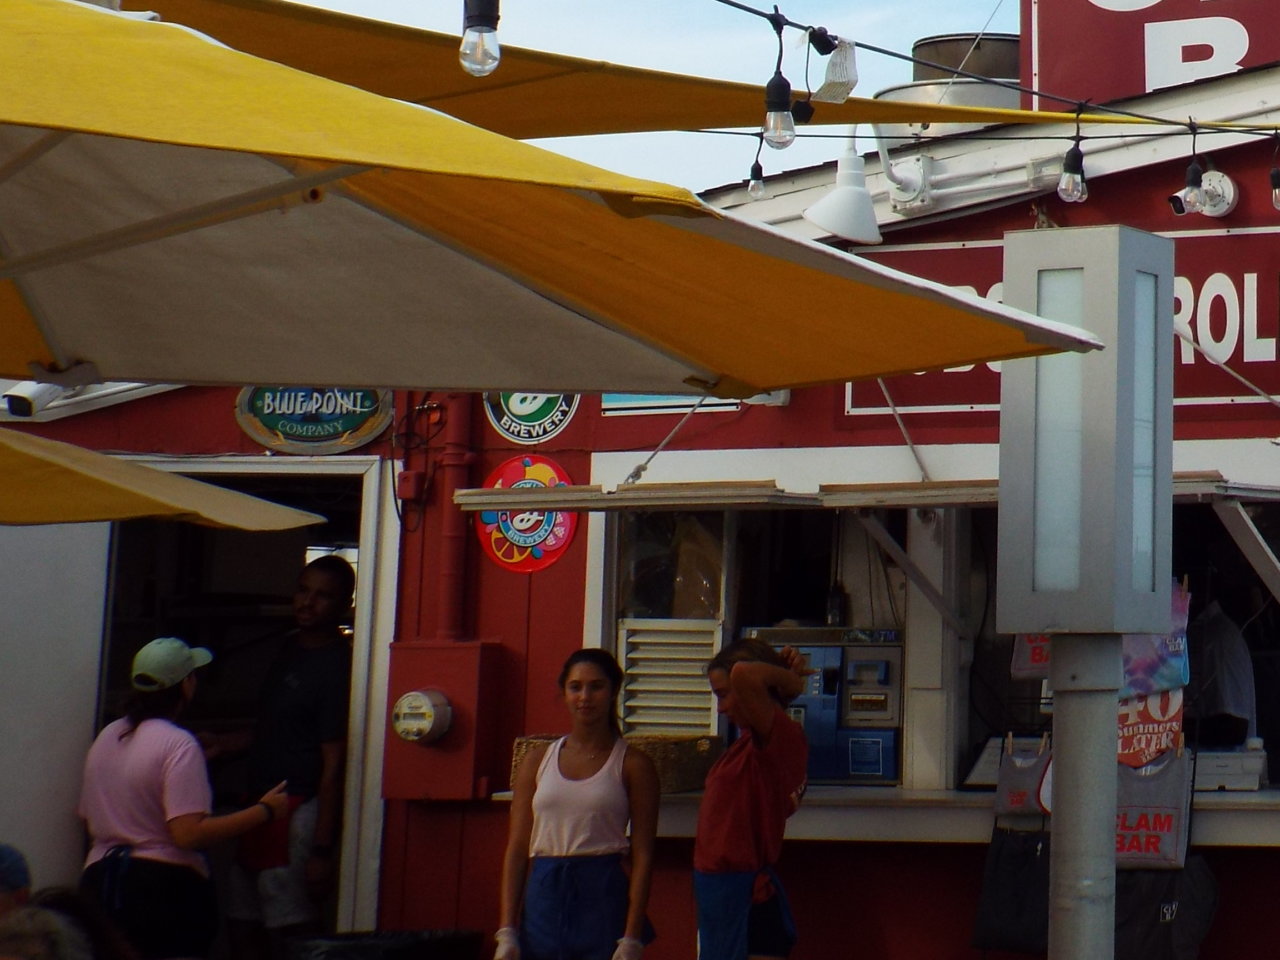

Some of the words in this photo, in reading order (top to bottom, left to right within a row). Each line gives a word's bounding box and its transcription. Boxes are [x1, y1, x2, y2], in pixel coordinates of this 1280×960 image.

[264, 392, 305, 414] BLUE
[311, 391, 363, 414] POINT
[278, 420, 343, 436] COMPANY
[500, 401, 570, 438] BREWERY
[507, 525, 550, 545] BREWERY
[1117, 731, 1174, 754] LATER
[1116, 813, 1173, 832] LAM
